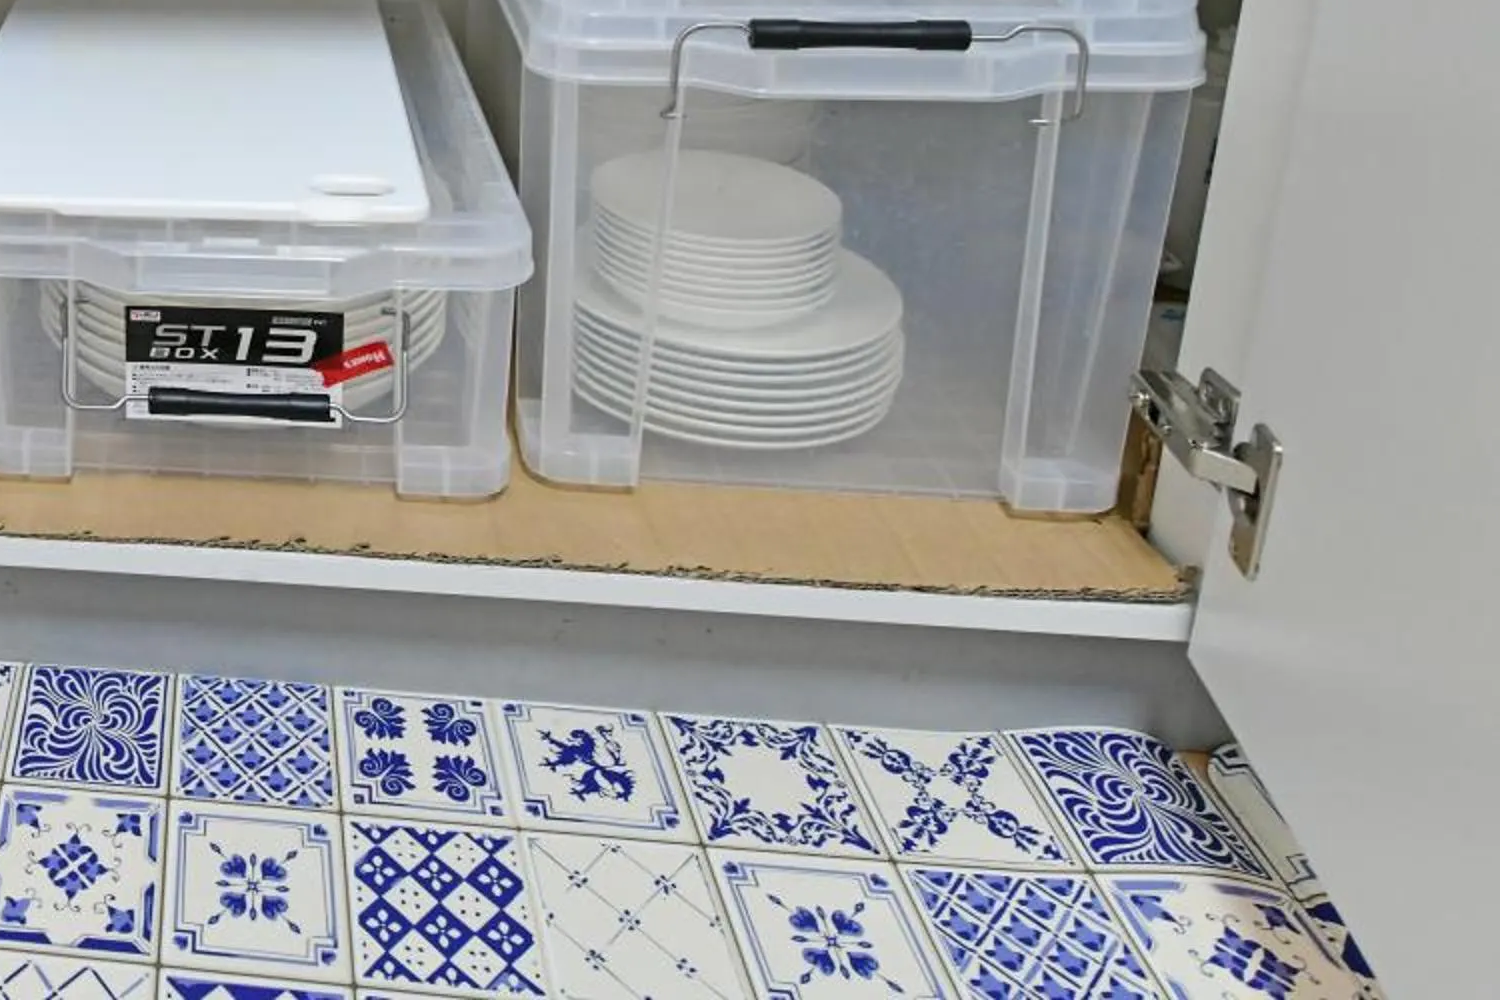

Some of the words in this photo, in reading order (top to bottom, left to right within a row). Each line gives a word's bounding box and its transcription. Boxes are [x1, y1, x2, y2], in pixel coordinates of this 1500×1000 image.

[149, 347, 219, 360] BOX
[151, 324, 226, 347] ST
[235, 327, 318, 365] 13
